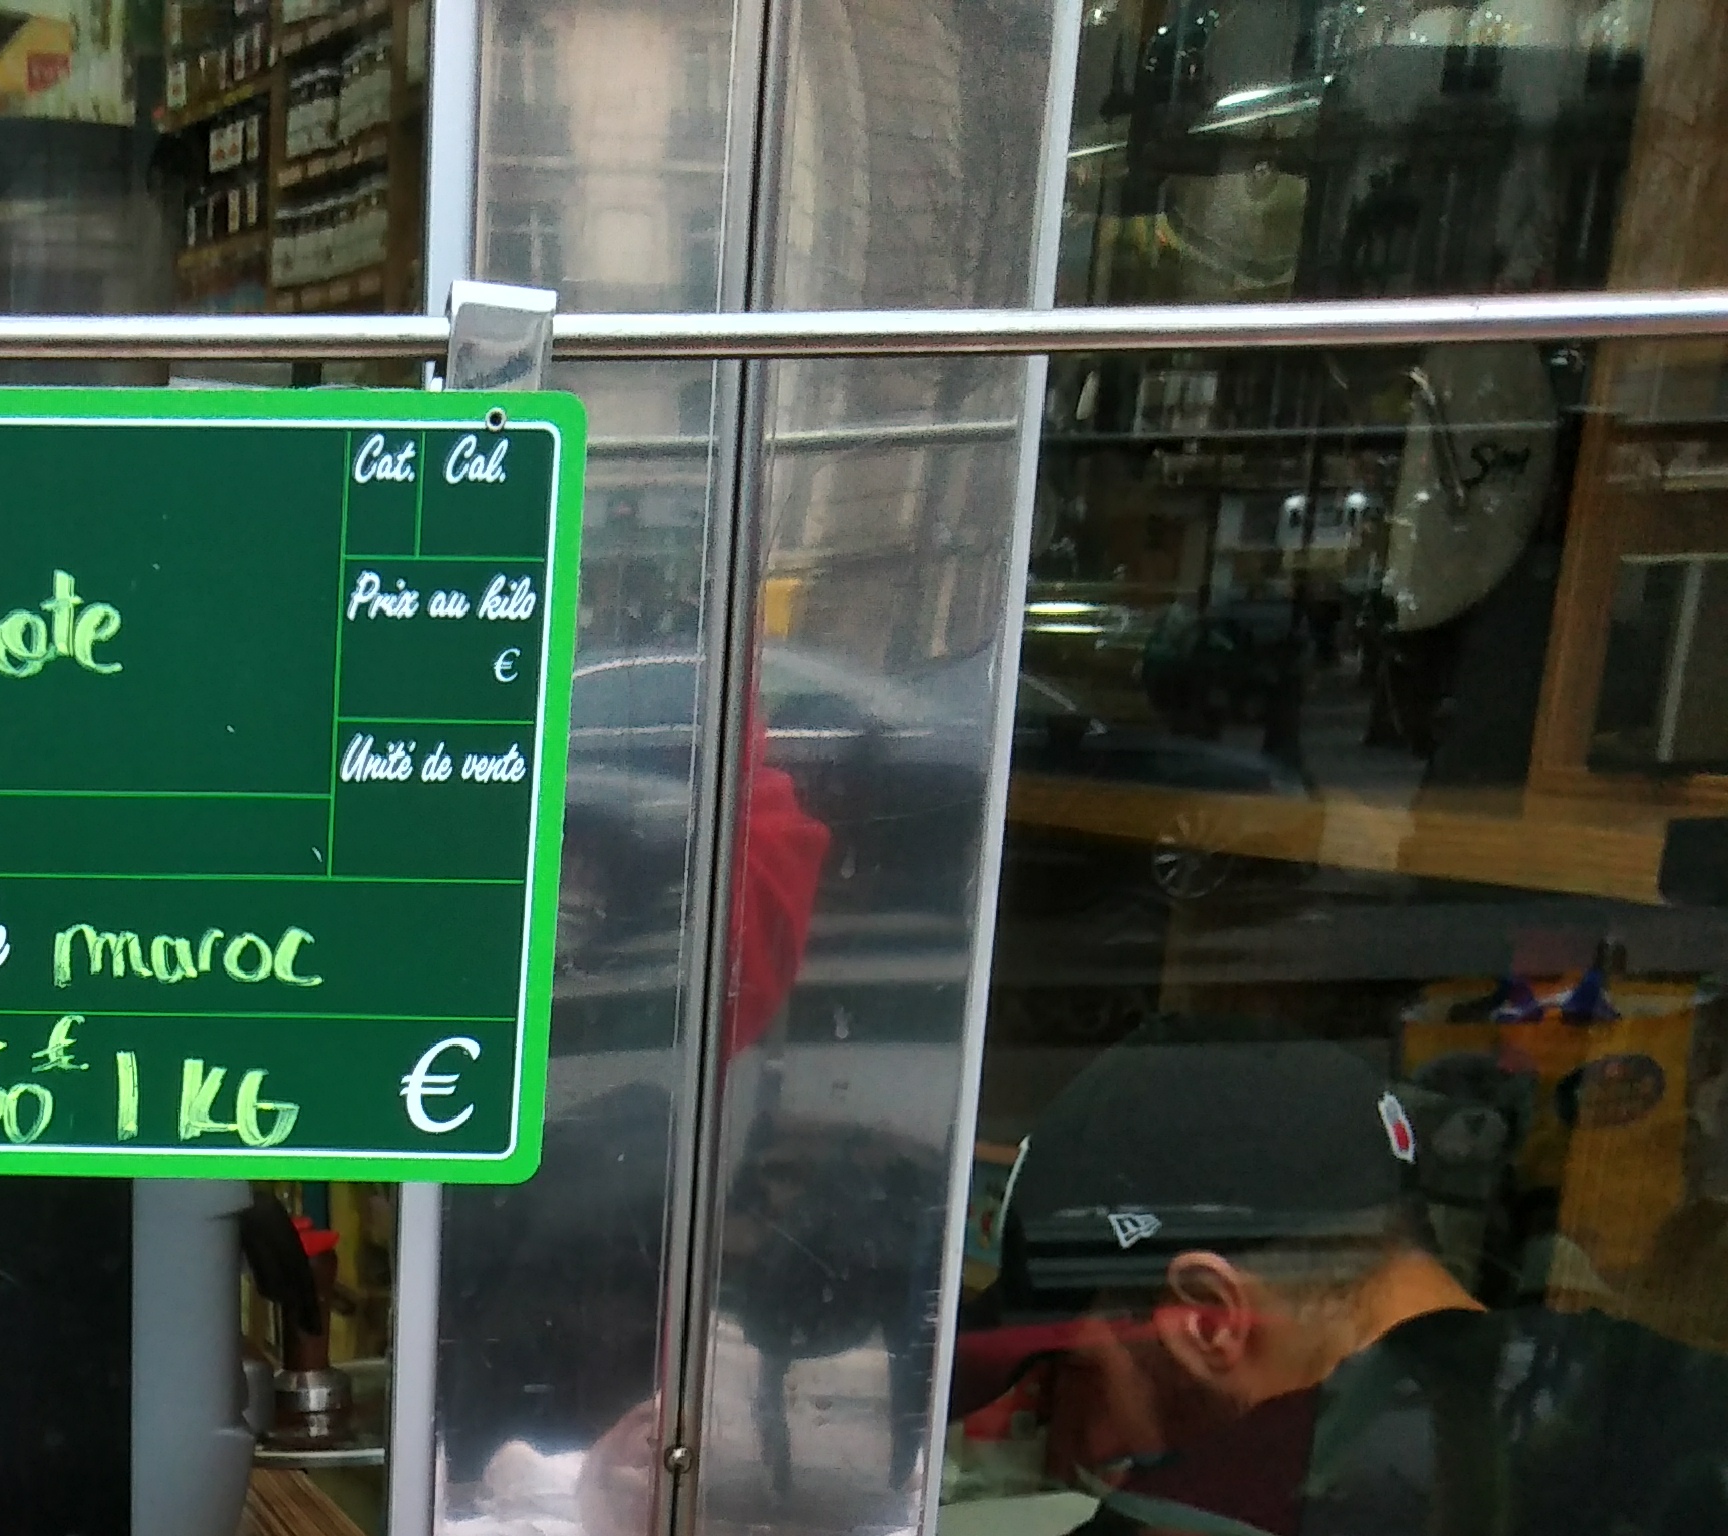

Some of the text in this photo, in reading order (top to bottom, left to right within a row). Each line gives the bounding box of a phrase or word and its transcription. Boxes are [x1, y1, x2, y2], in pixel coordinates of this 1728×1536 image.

[353, 433, 415, 484] Cat.
[444, 433, 509, 484] Cal.
[346, 570, 537, 621] Prix au kilo
[493, 648, 520, 682] €
[340, 733, 526, 783] Unité de vente
[53, 923, 324, 988] maroc
[179, 1058, 300, 1147] KG
[399, 1036, 480, 1134] €
